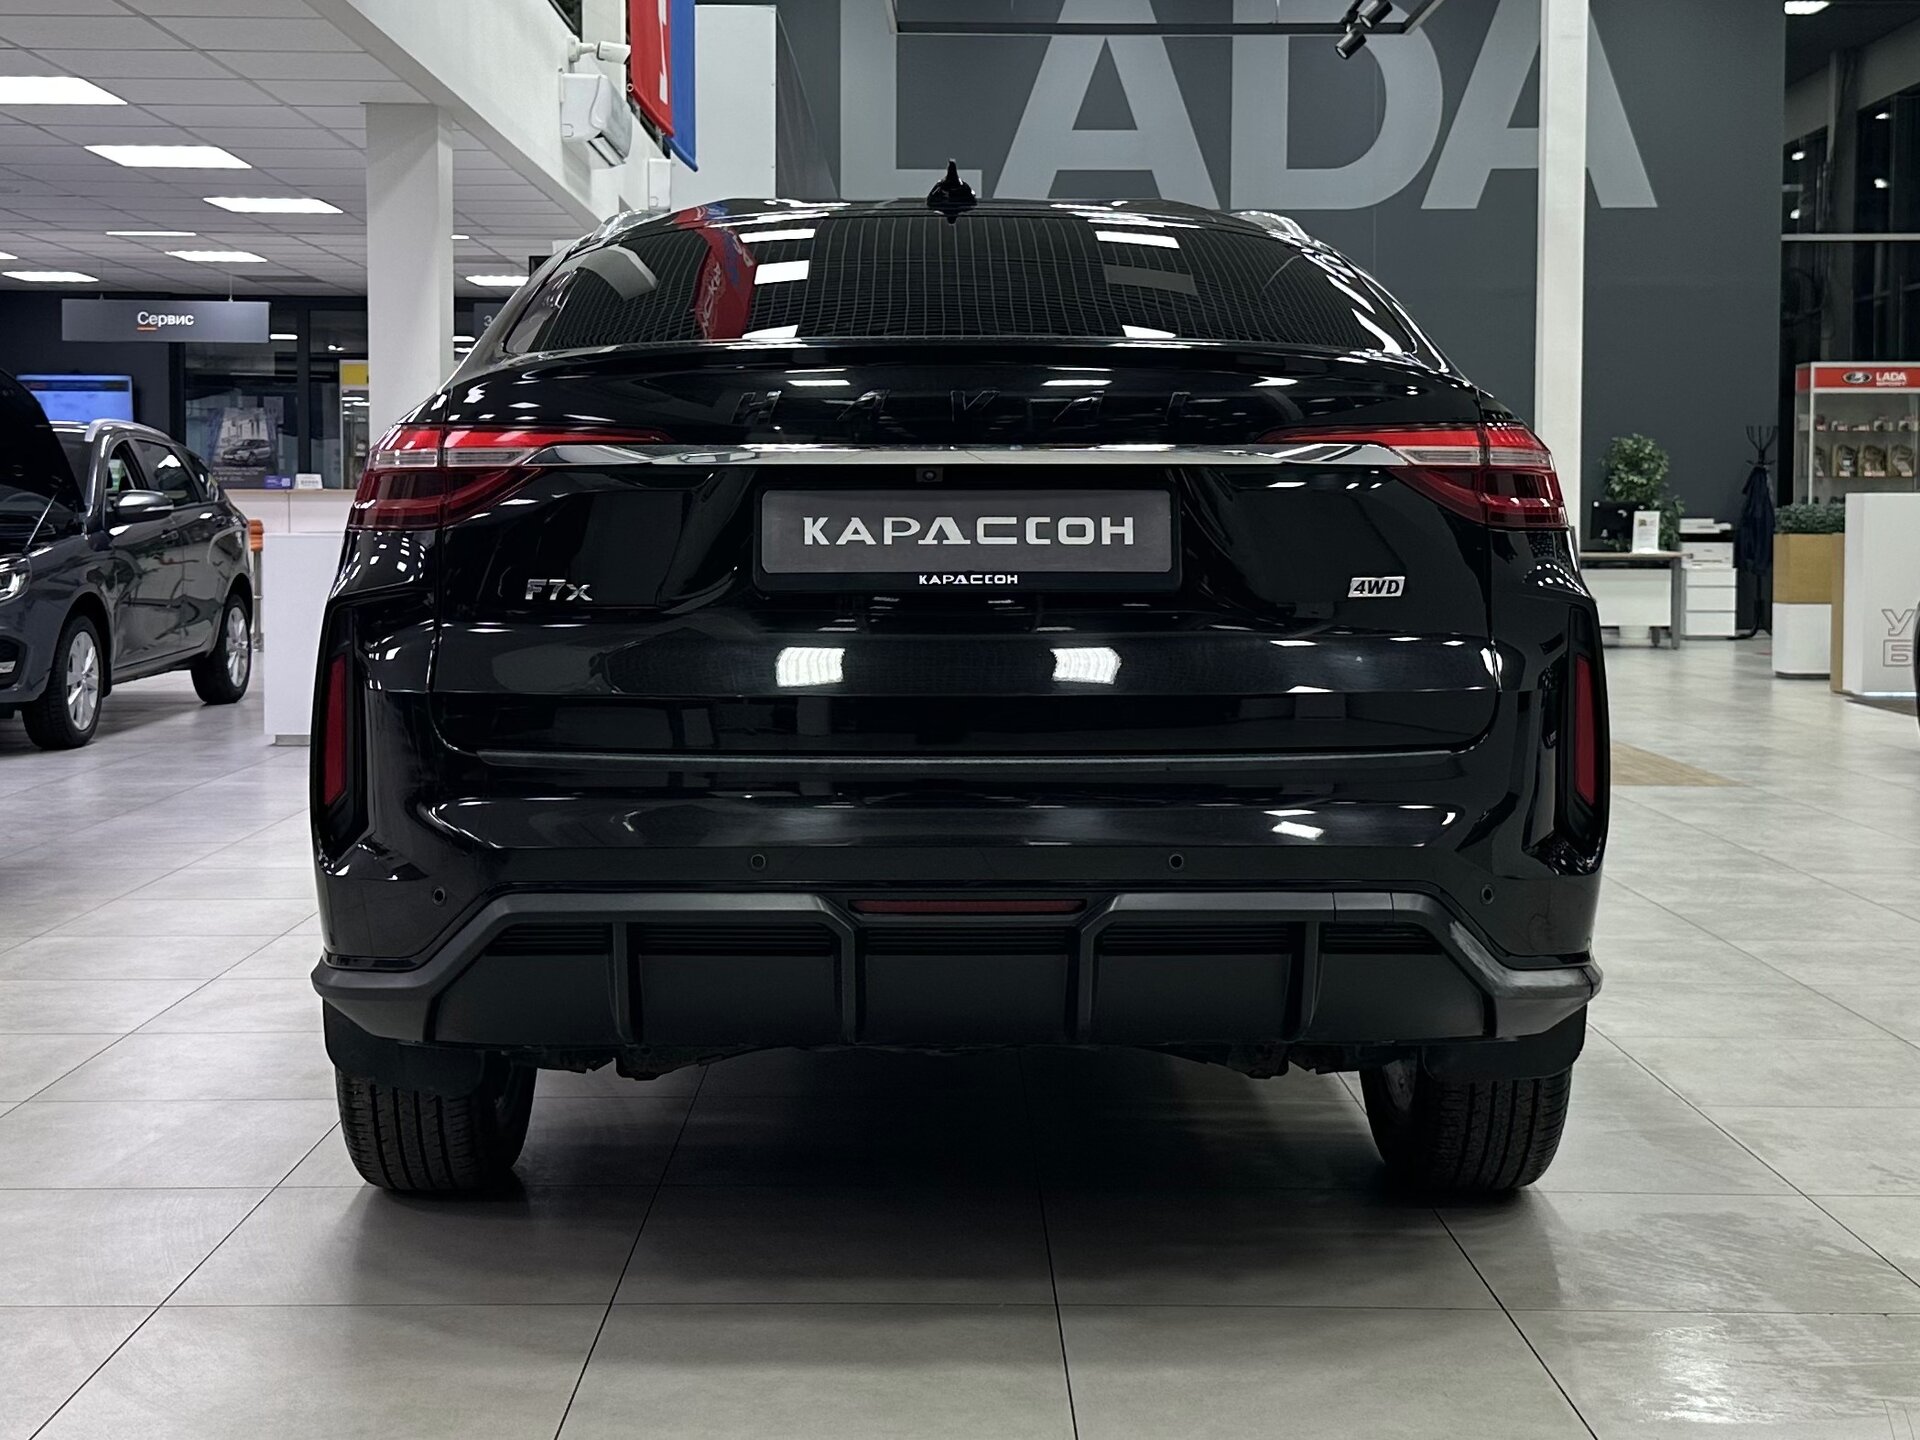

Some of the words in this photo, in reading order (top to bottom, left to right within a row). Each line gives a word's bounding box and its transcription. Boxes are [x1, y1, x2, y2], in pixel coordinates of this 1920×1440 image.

[840, 0, 1658, 210] LADA
[137, 311, 194, 327] Сервис
[1876, 372, 1906, 381] LADA
[803, 517, 1134, 545] КАРАССОН
[919, 574, 1018, 585] КАРАССОН
[1351, 579, 1401, 595] 4WD
